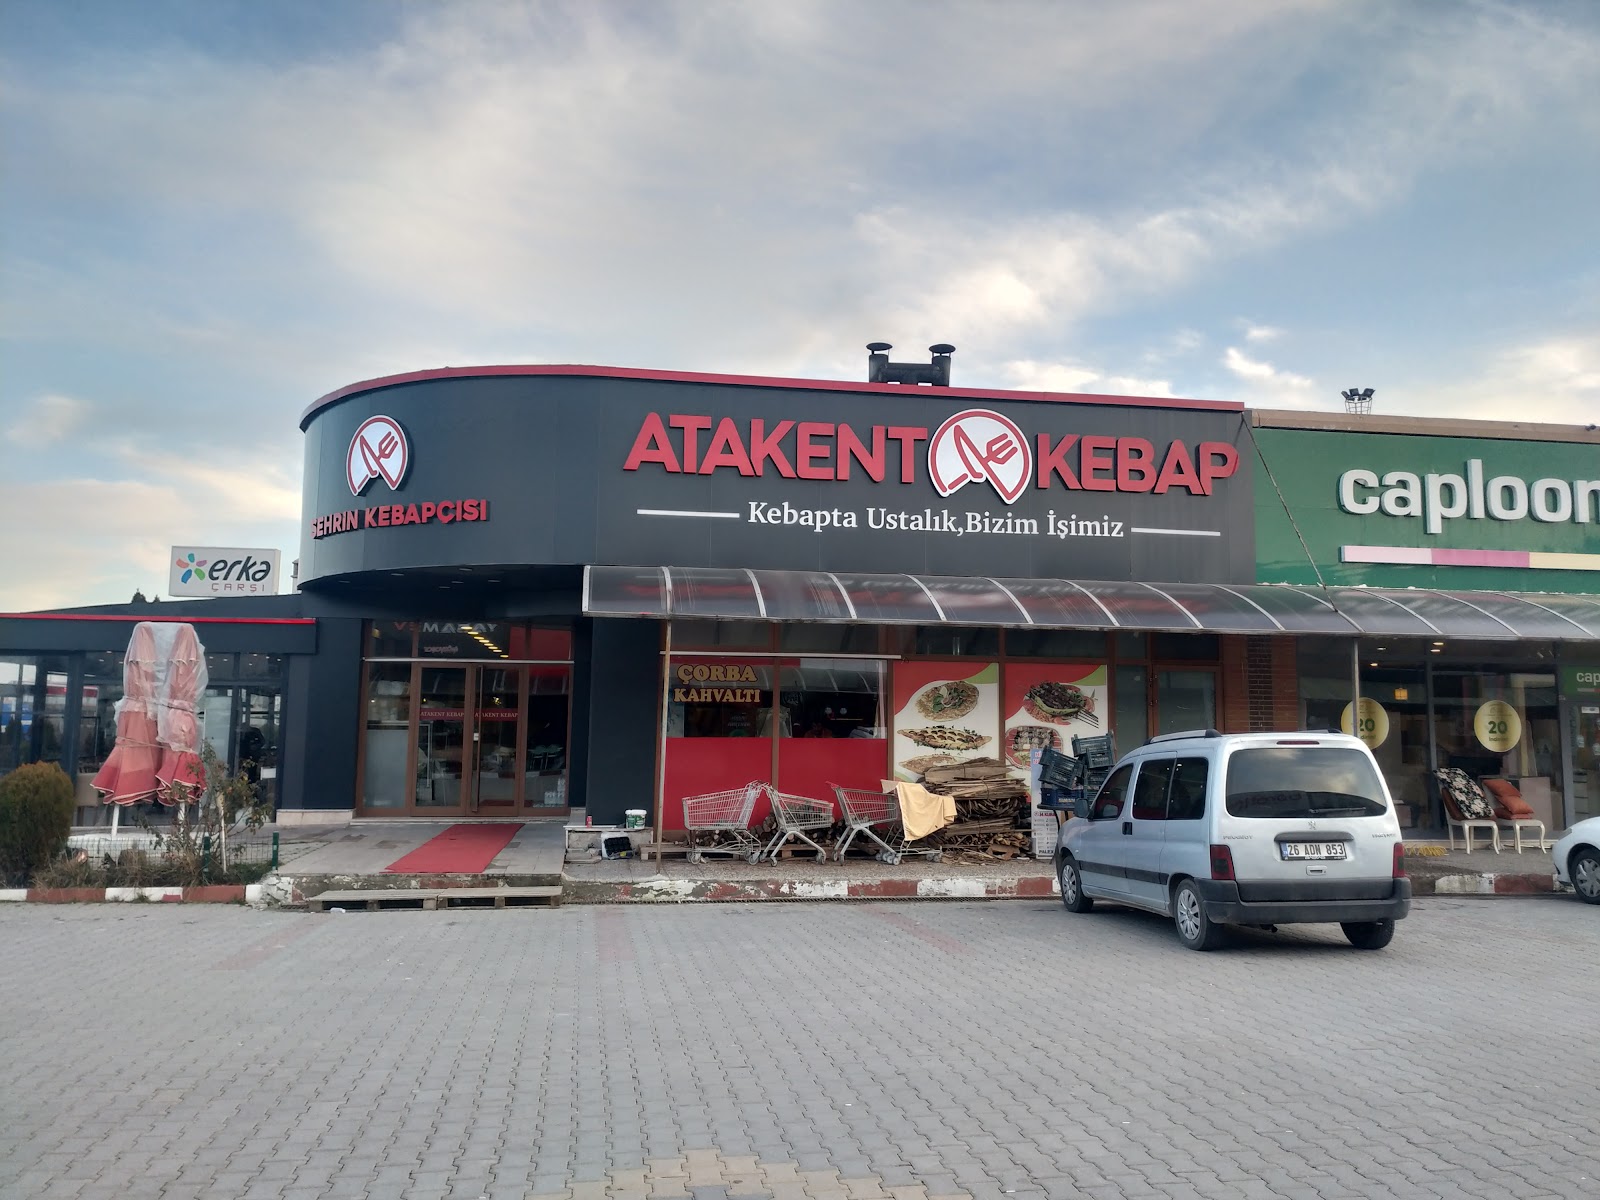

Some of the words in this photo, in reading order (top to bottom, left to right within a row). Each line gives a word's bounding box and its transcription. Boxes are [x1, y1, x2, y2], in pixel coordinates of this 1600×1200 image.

[623, 411, 928, 483] ATAKENT
[1036, 432, 1240, 496] KEBAP
[1338, 458, 1600, 534] caploon
[748, 501, 858, 533] Kebapta
[1046, 509, 1124, 540] İşimiz
[208, 555, 271, 582] erka
[211, 583, 265, 592] ÇARŞI
[677, 664, 758, 685] ÇORBA
[673, 687, 761, 703] KAHVALTI
[1487, 720, 1508, 735] 20
[1287, 844, 1300, 856] 26
[1304, 844, 1322, 856] ADN
[1325, 843, 1344, 855] 853
